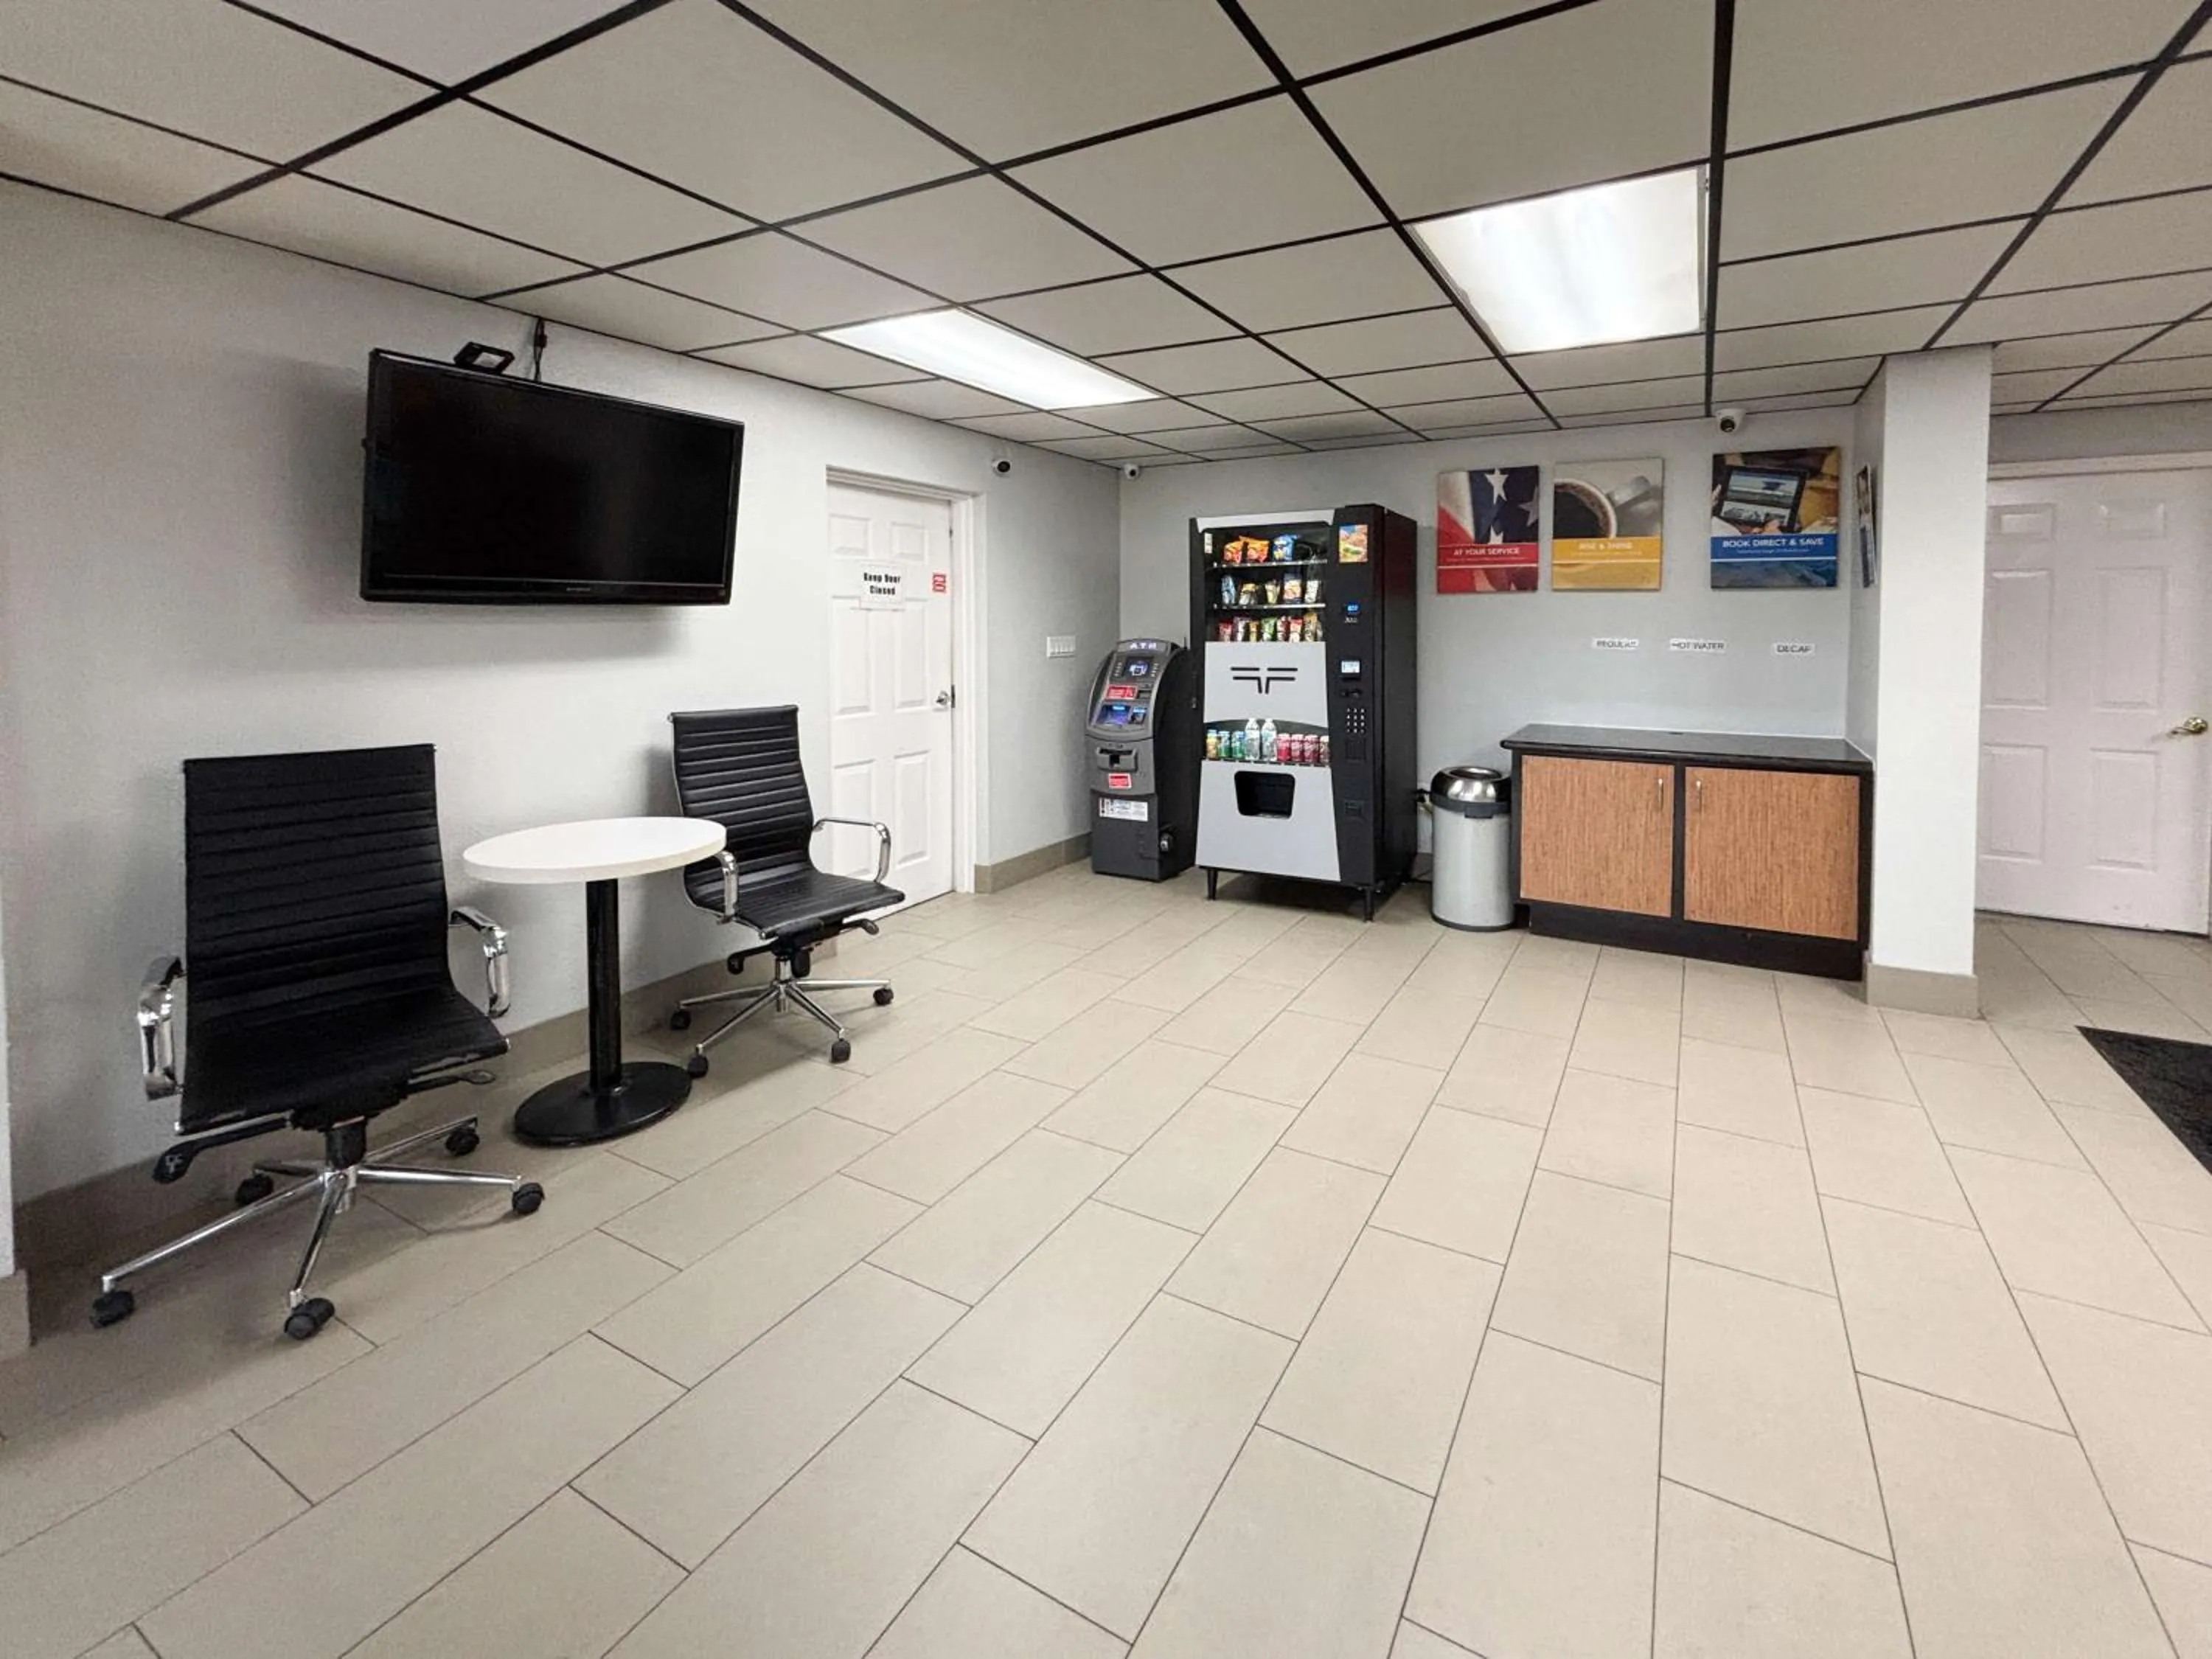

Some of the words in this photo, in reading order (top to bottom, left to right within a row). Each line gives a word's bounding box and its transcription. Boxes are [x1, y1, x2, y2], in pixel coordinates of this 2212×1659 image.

[1722, 539, 1750, 548] BOOK
[1752, 538, 1787, 547] DIRECT
[1799, 538, 1824, 546] SAVE
[1488, 547, 1520, 555] SERVICE
[863, 572, 883, 582] Keep
[869, 585, 895, 595] Closed
